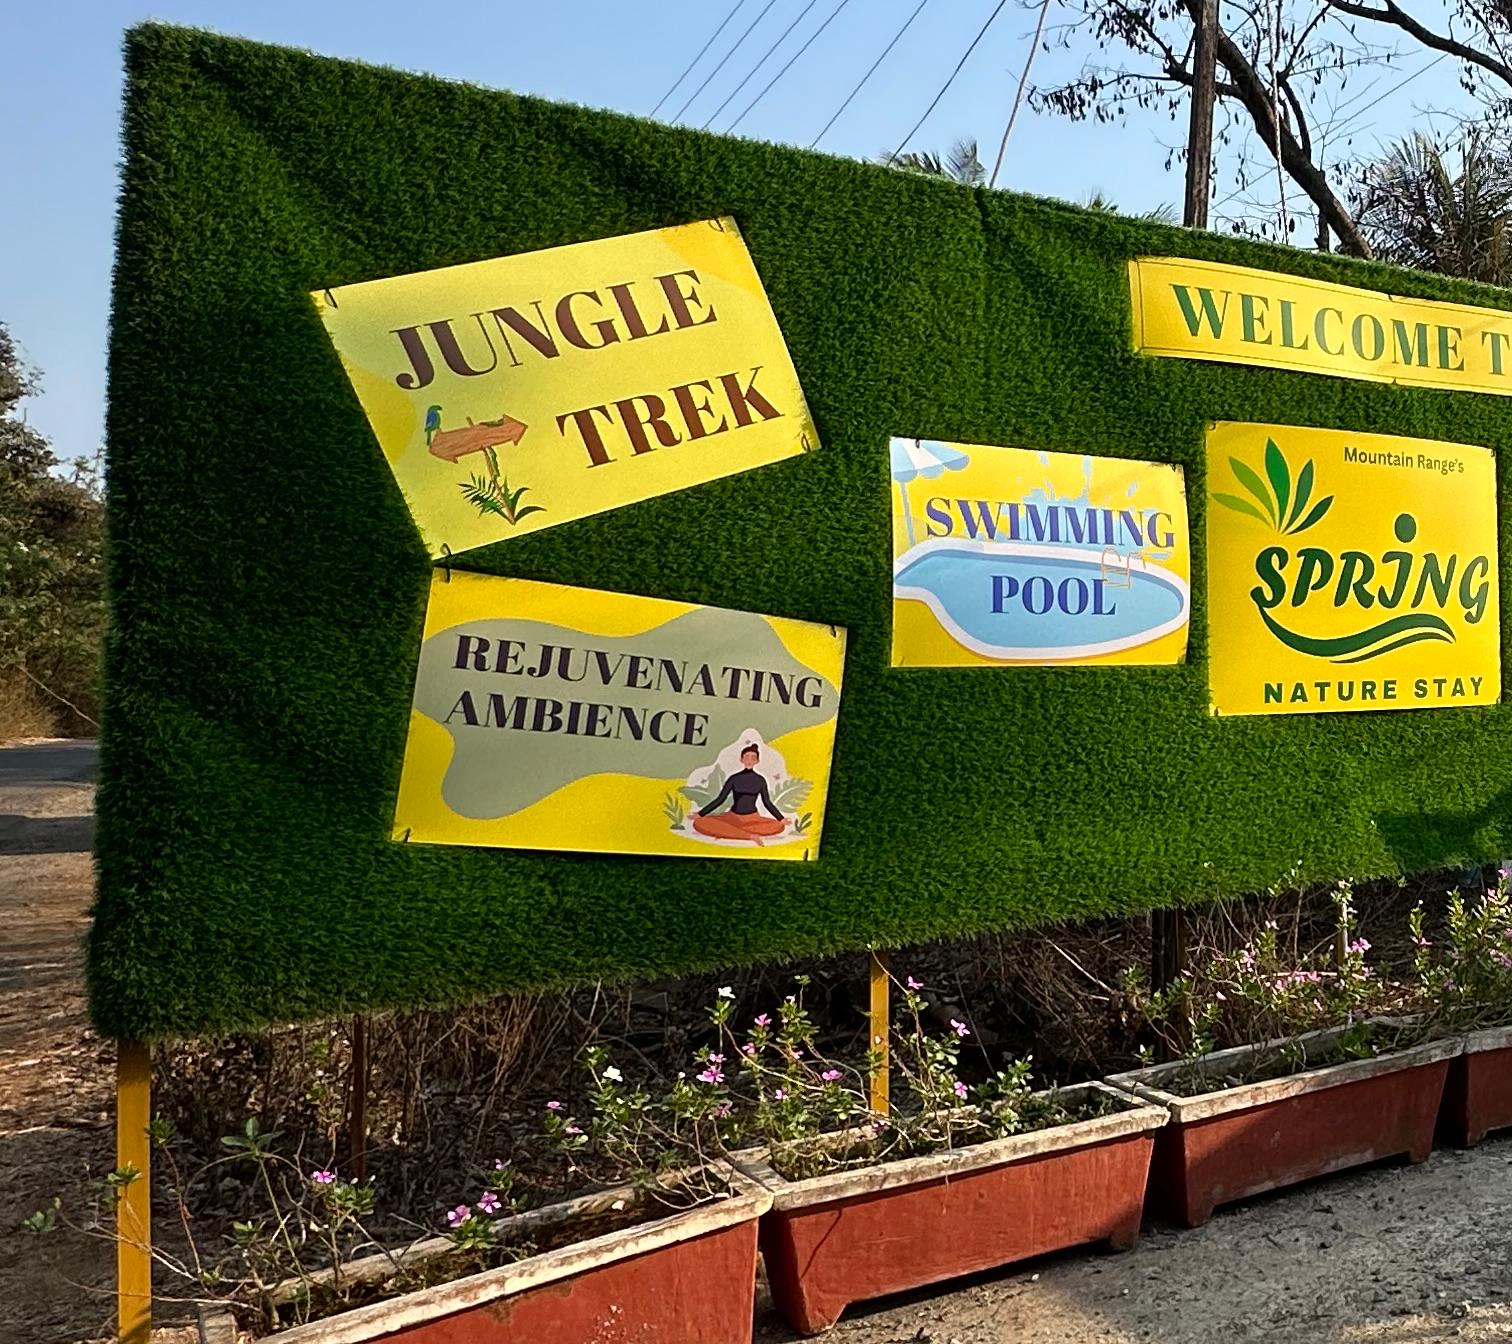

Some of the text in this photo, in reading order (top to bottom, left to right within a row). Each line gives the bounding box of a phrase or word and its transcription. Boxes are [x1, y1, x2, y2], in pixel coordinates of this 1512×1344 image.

[389, 269, 718, 391] JUNGLE
[1170, 282, 1466, 373] WELCOME
[555, 365, 785, 469] TREK
[1343, 446, 1465, 476] Mountain Range's
[925, 496, 1176, 549] SWIMMING
[989, 573, 1117, 616] POOL
[451, 633, 824, 709] REJUVENATING
[1263, 676, 1484, 705] NATURE STAY
[443, 689, 710, 748] AMBIENCE
